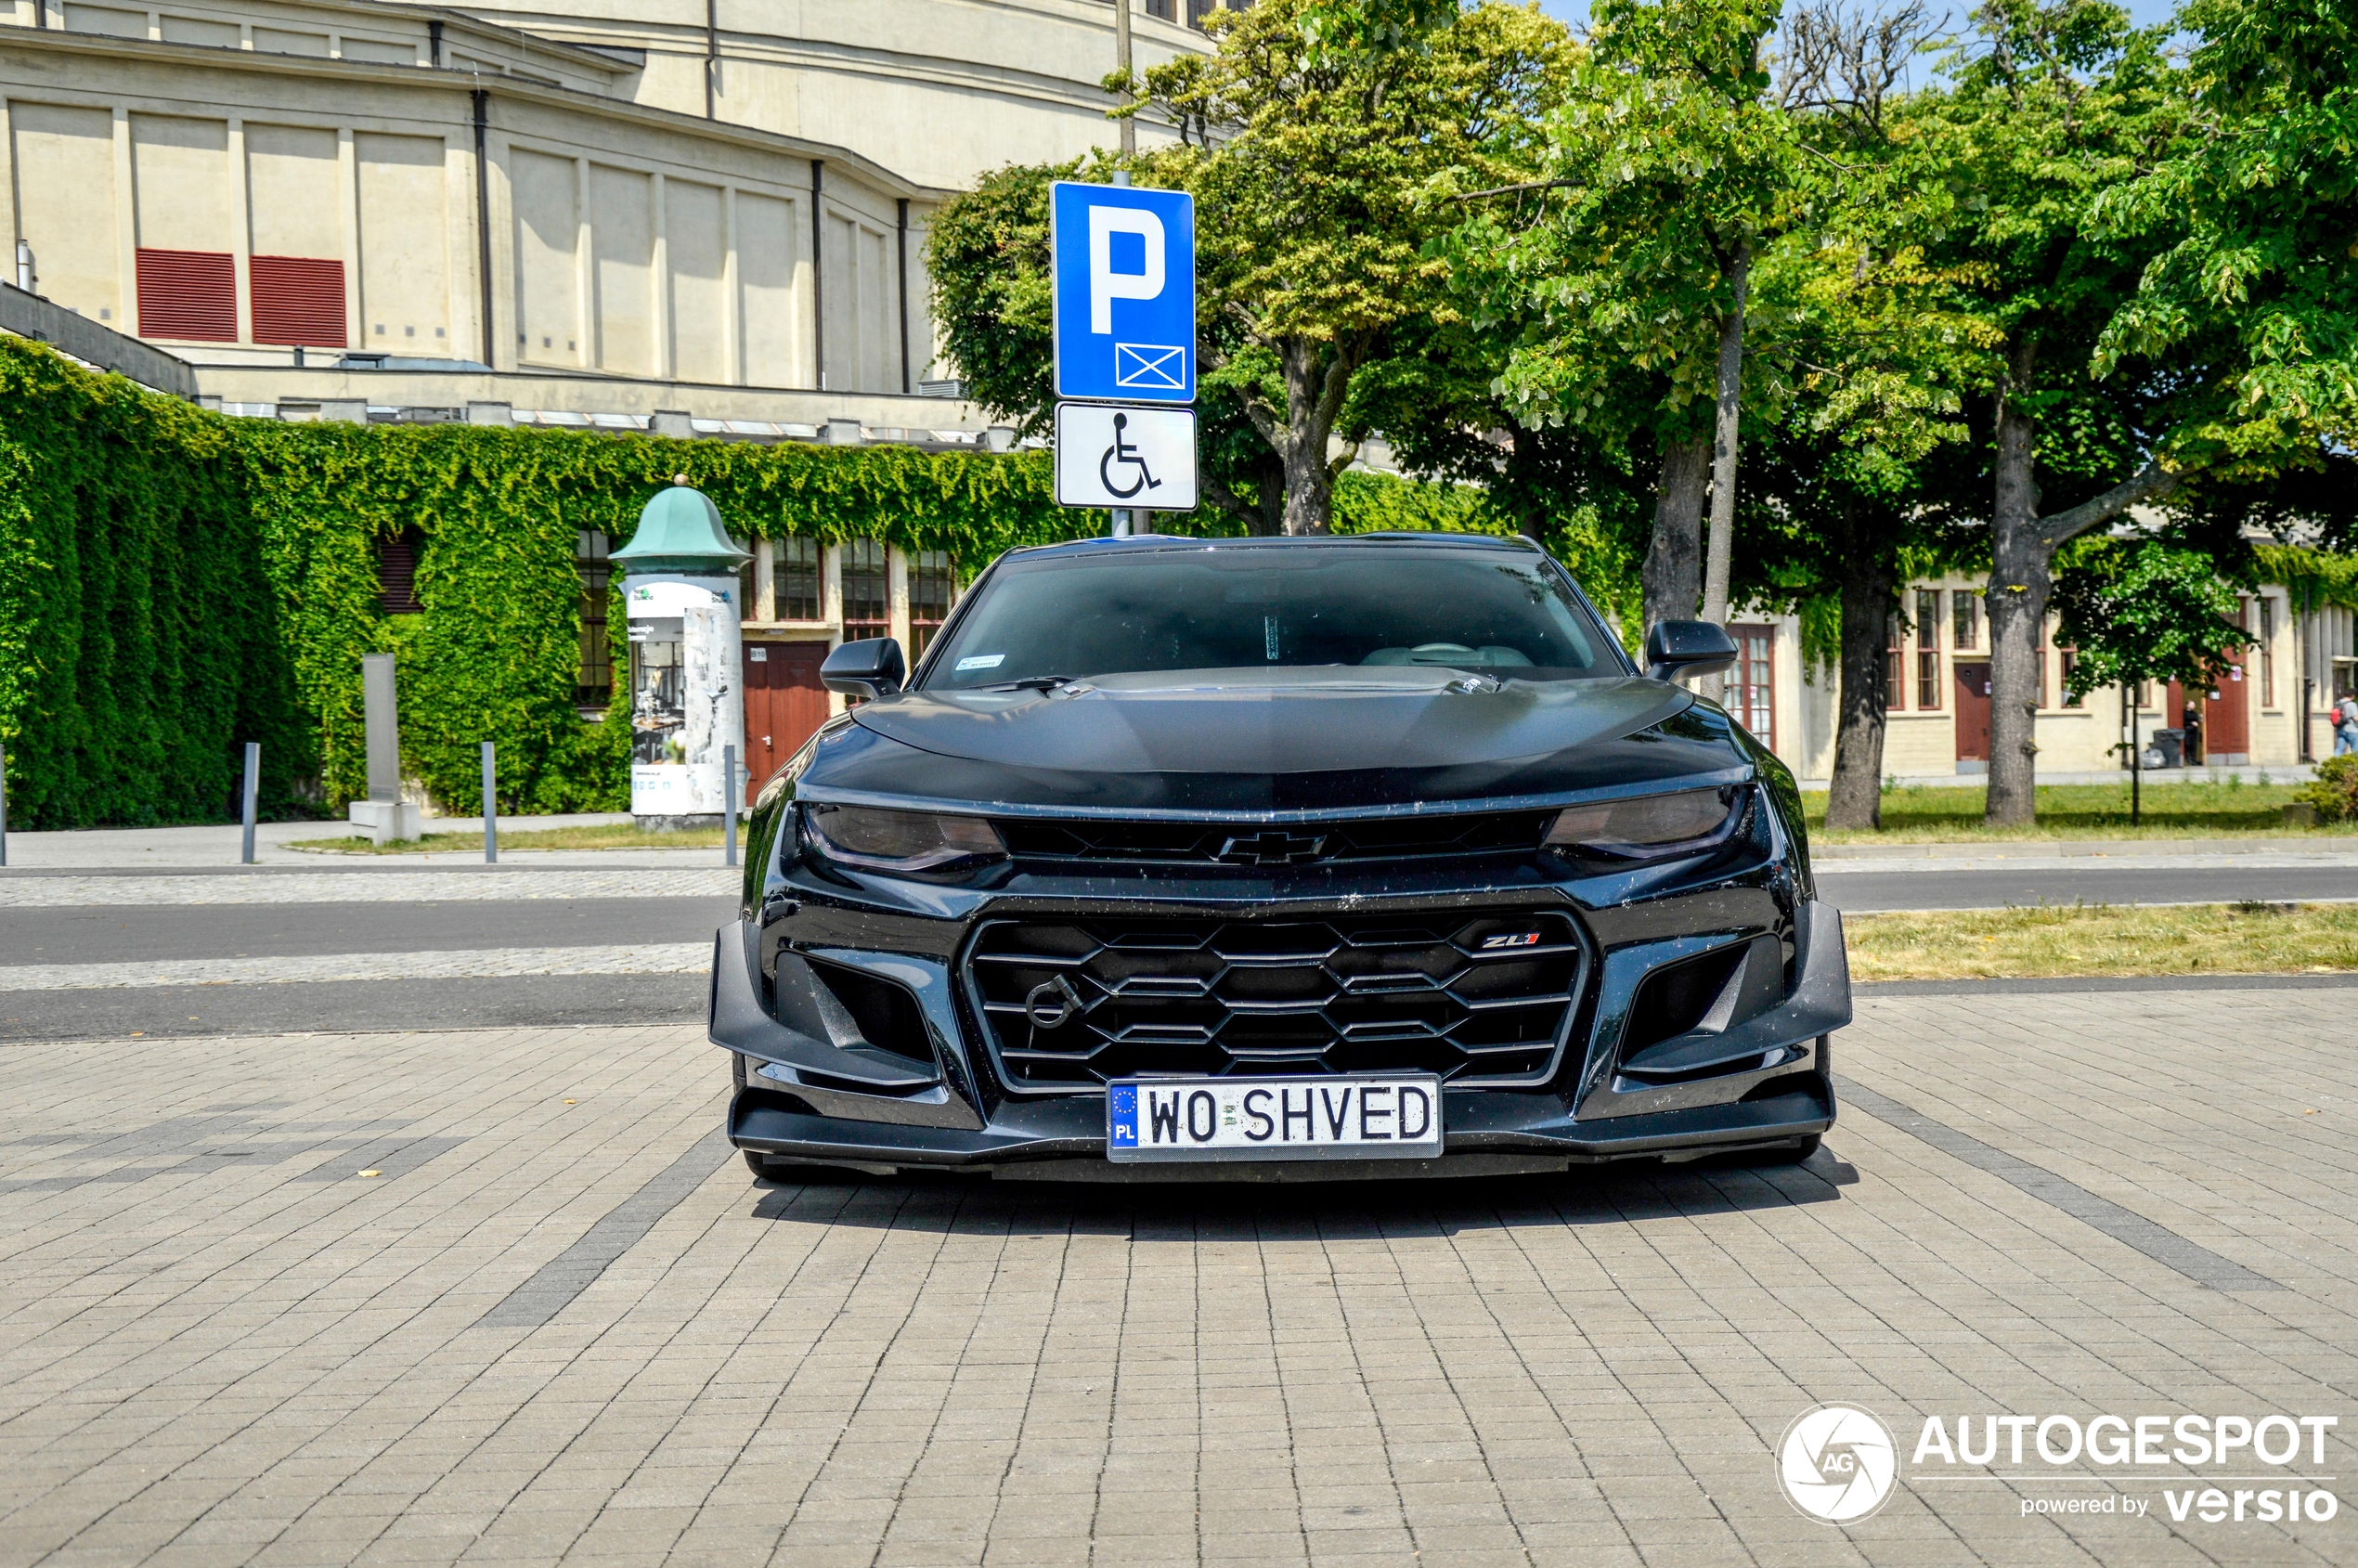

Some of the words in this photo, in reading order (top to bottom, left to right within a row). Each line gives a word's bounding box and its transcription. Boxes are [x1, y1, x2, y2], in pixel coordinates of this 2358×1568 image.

[1089, 205, 1165, 334] P
[1483, 933, 1540, 949] ZL1
[1115, 1124, 1135, 1141] PL
